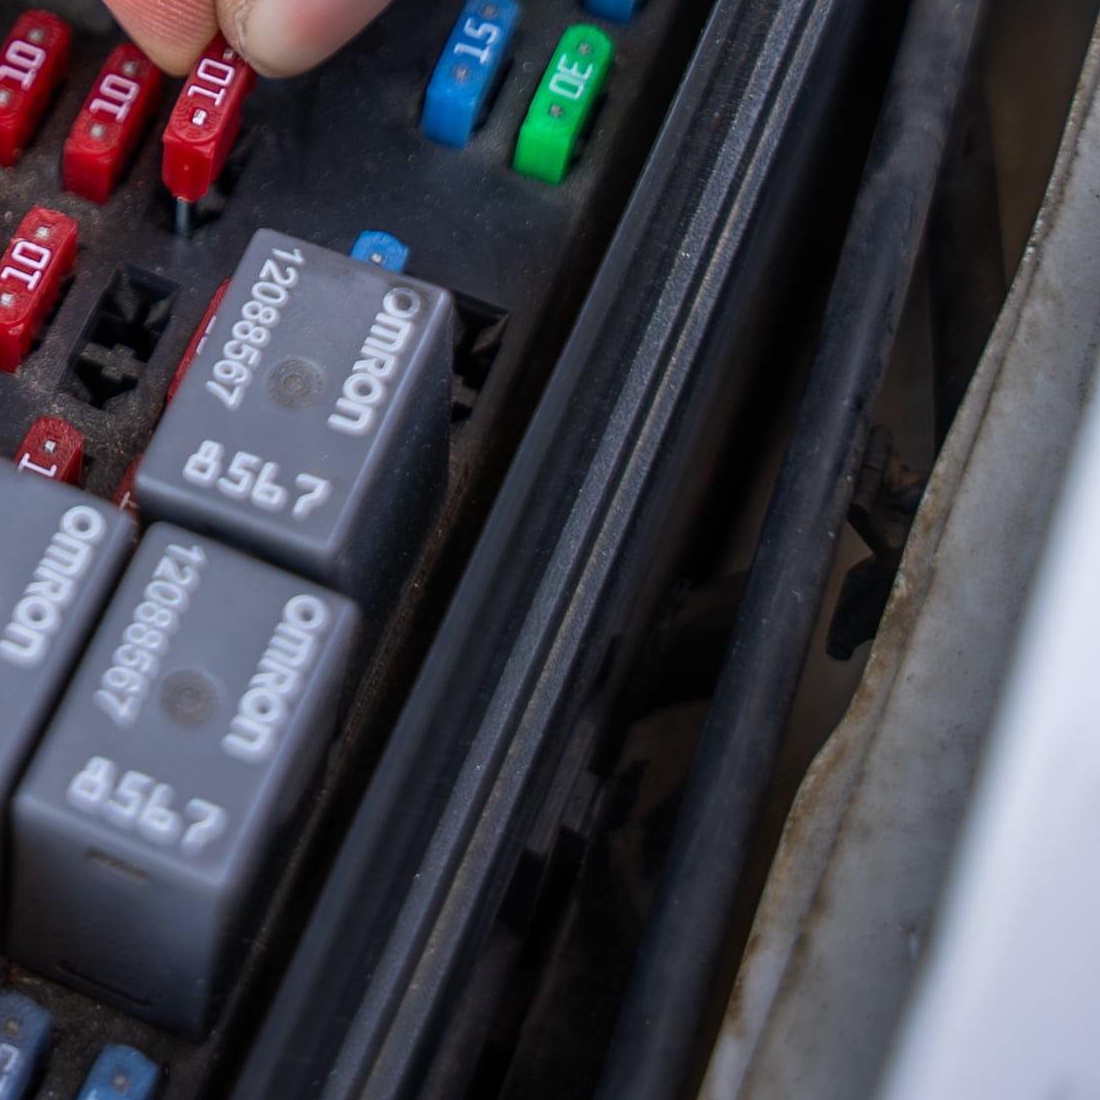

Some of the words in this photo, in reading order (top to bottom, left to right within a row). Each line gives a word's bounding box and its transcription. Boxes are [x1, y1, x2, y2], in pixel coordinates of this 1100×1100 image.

[453, 17, 499, 65] 15
[89, 72, 142, 123] 10
[187, 58, 235, 107] 10
[548, 54, 594, 101] 30
[1, 238, 53, 292] 10
[205, 246, 307, 411] 12088567
[183, 439, 332, 519] 8567
[93, 542, 207, 728] 12088567
[67, 755, 227, 853] 8567
